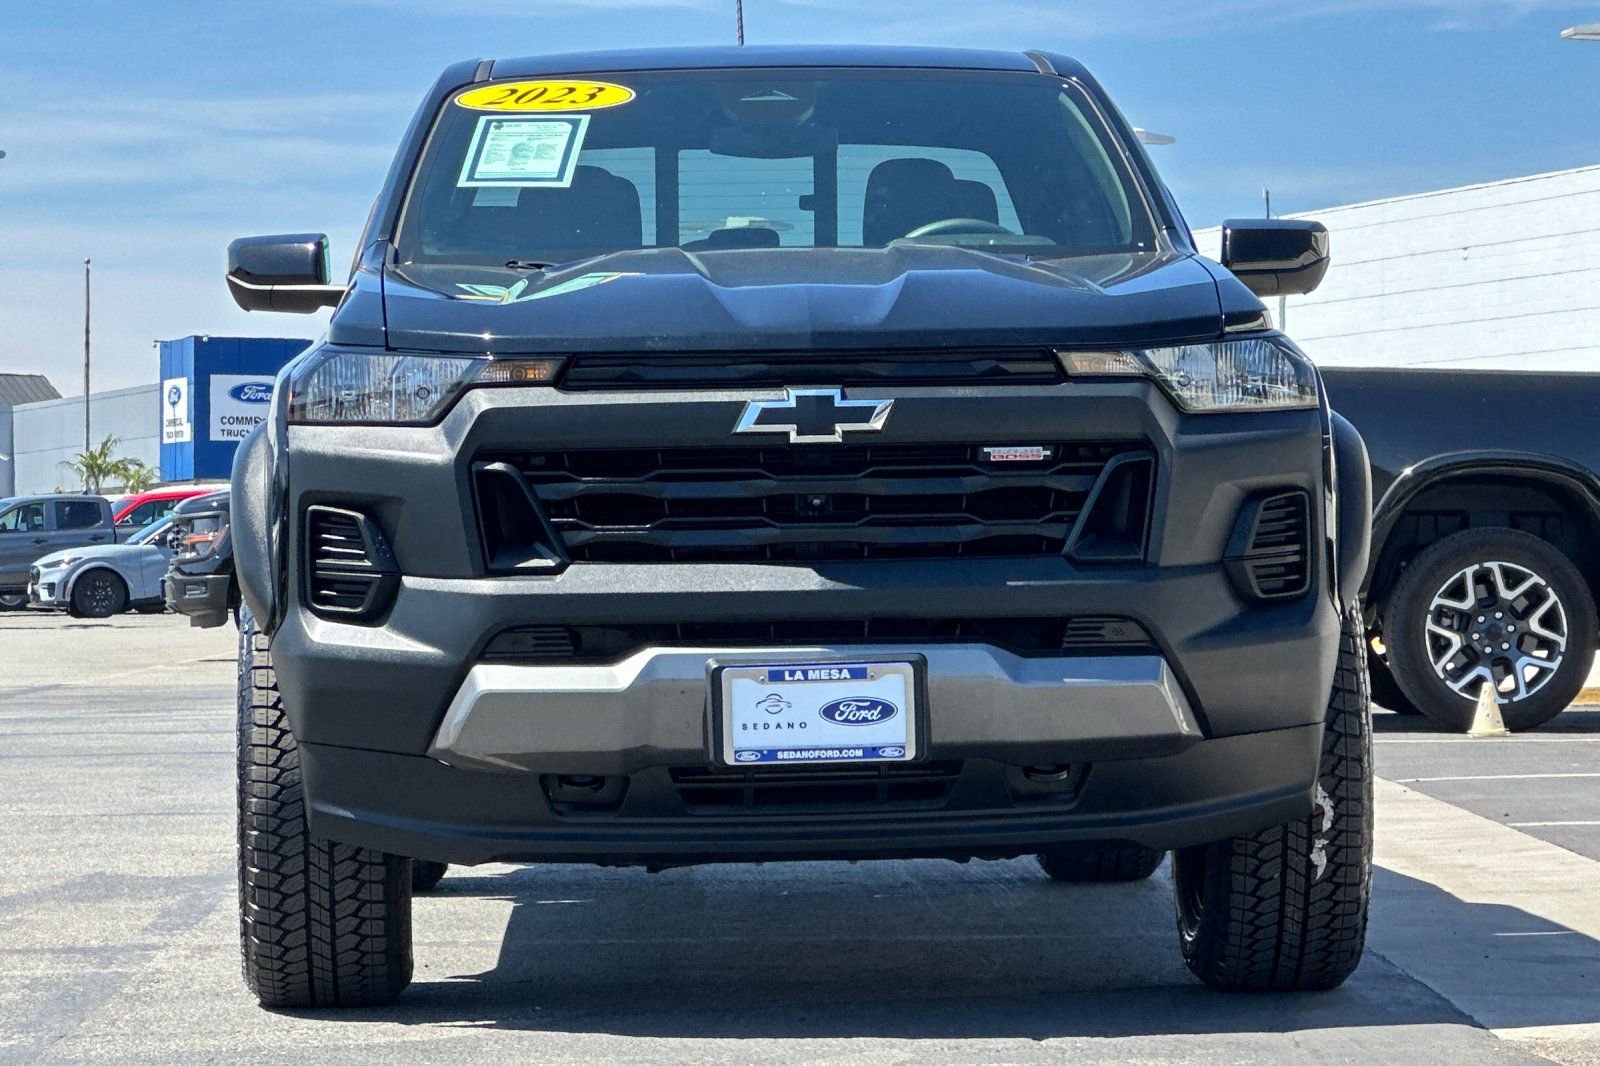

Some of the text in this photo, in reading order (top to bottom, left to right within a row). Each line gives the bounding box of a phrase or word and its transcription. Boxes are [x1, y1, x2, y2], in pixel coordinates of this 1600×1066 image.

[481, 86, 607, 106] 2023
[784, 668, 851, 681] LA MESA
[834, 701, 883, 721] Ford
[741, 721, 808, 731] SEDANO
[776, 749, 864, 760] SEDANOFORD.COM
